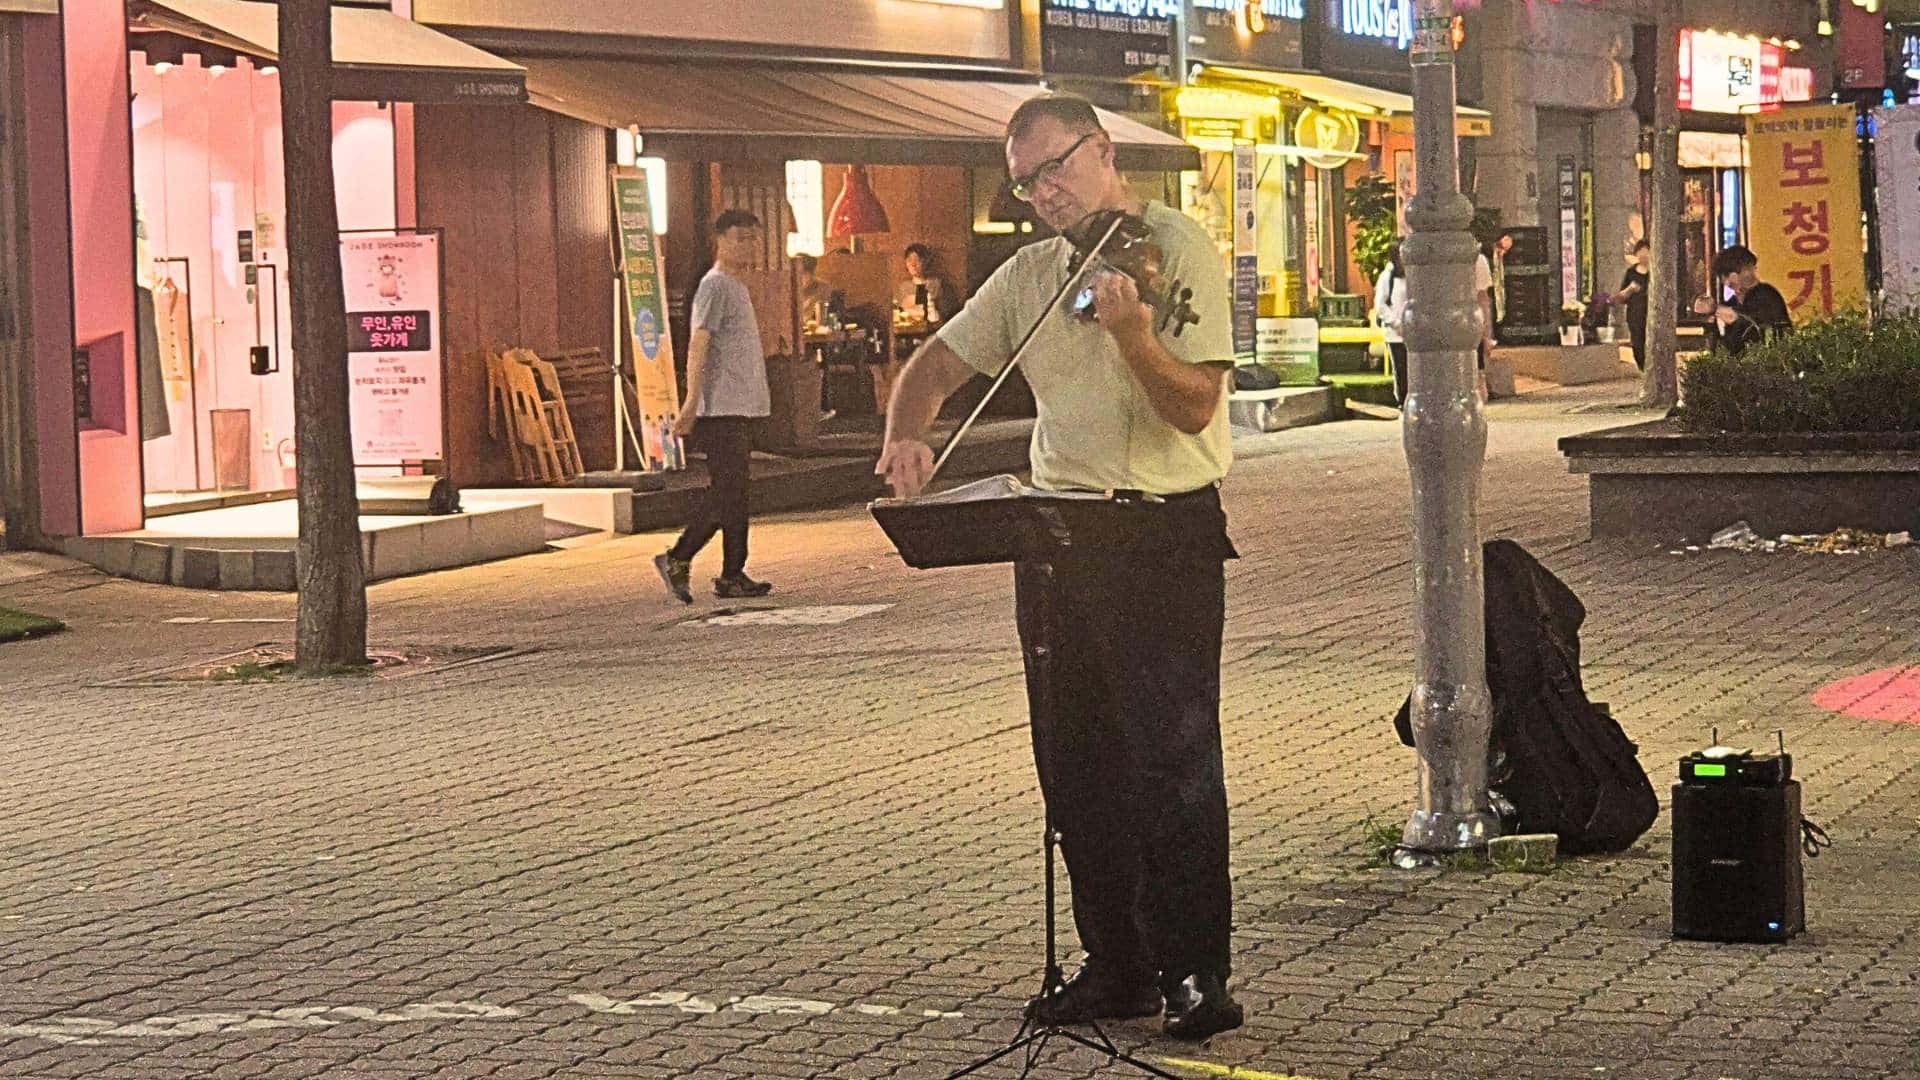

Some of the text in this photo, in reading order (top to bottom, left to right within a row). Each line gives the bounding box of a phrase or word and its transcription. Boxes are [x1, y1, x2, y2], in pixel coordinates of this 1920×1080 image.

[1076, 12, 1098, 30] GOLD
[1779, 139, 1834, 315] 보청기
[369, 332, 409, 348] 옷가게
